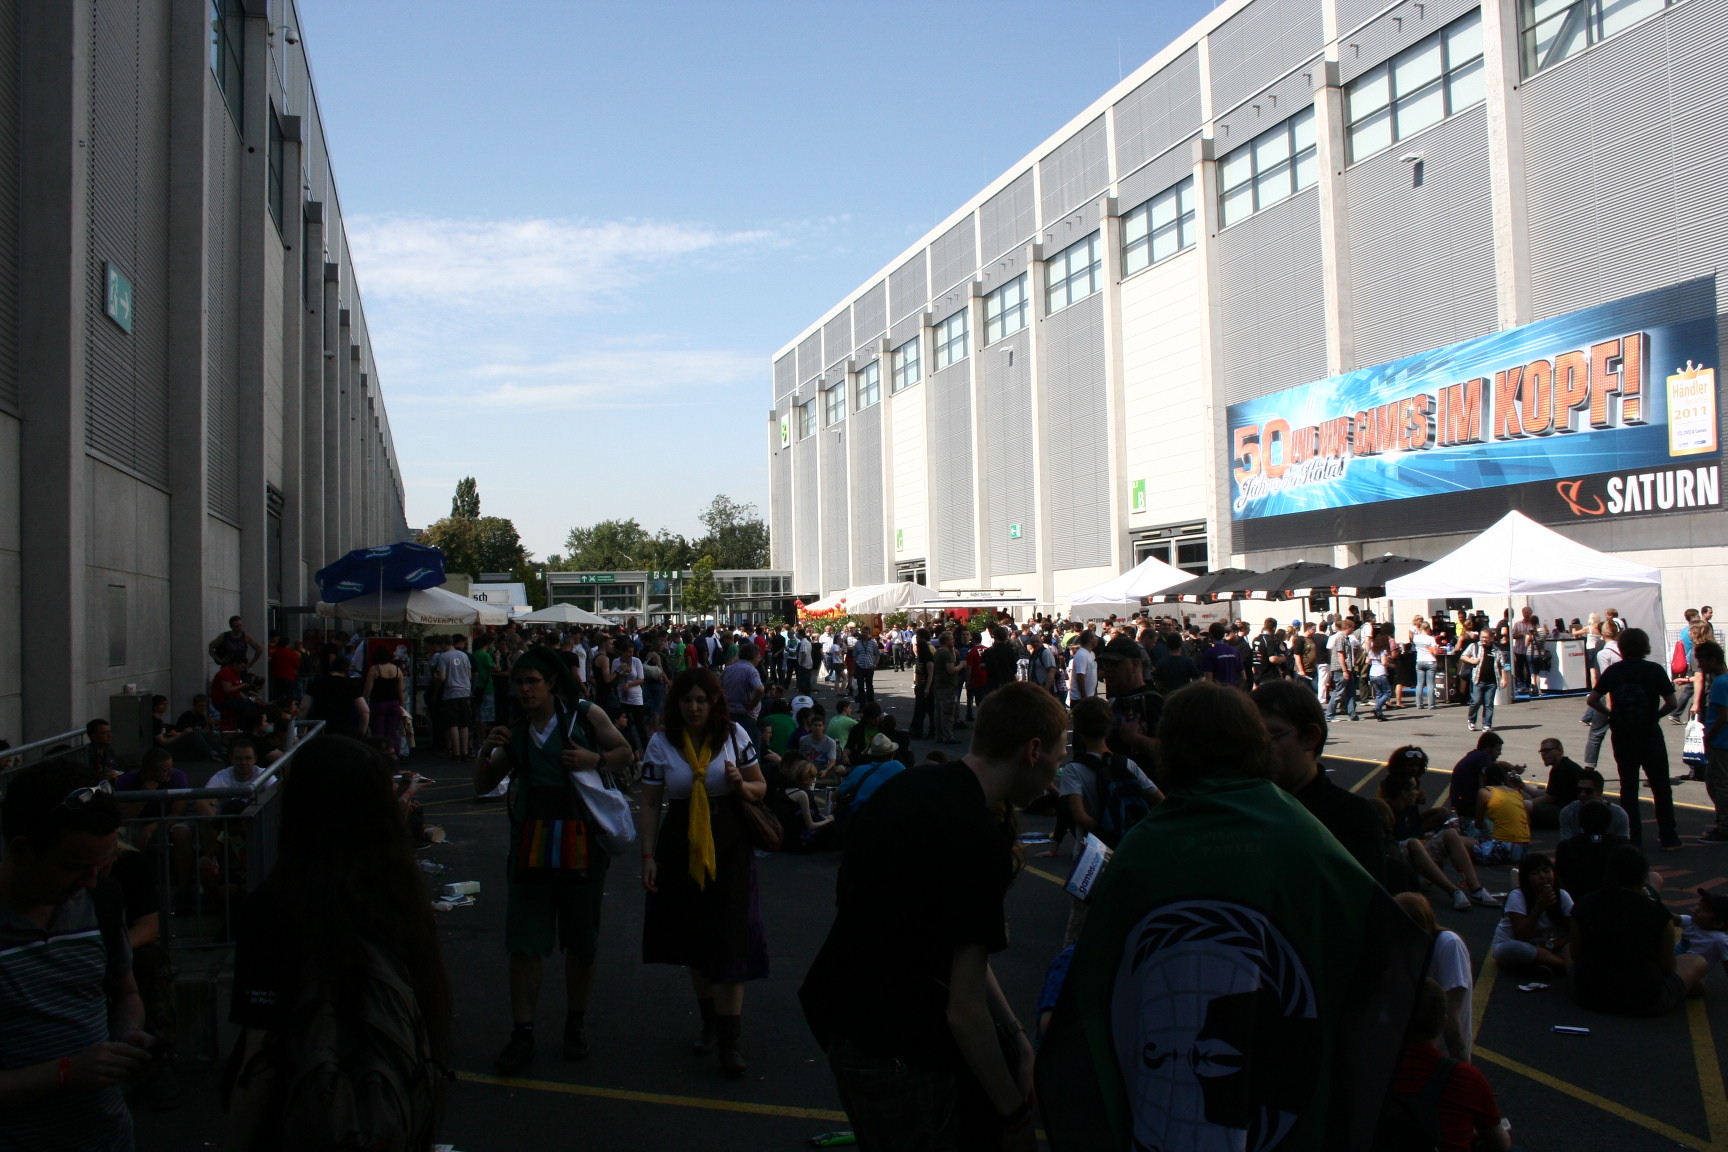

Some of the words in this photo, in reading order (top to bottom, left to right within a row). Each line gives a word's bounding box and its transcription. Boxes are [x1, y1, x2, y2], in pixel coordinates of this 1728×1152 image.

[1233, 418, 1291, 482] 50
[1291, 426, 1319, 465] UND
[1319, 416, 1354, 459] NUR
[1353, 393, 1436, 457] GAMES
[1437, 377, 1490, 447] IM
[1494, 330, 1650, 441] KOPF!
[1672, 380, 1708, 399] Händler
[1674, 405, 1707, 420] 2011
[1607, 465, 1719, 514] SATURN
